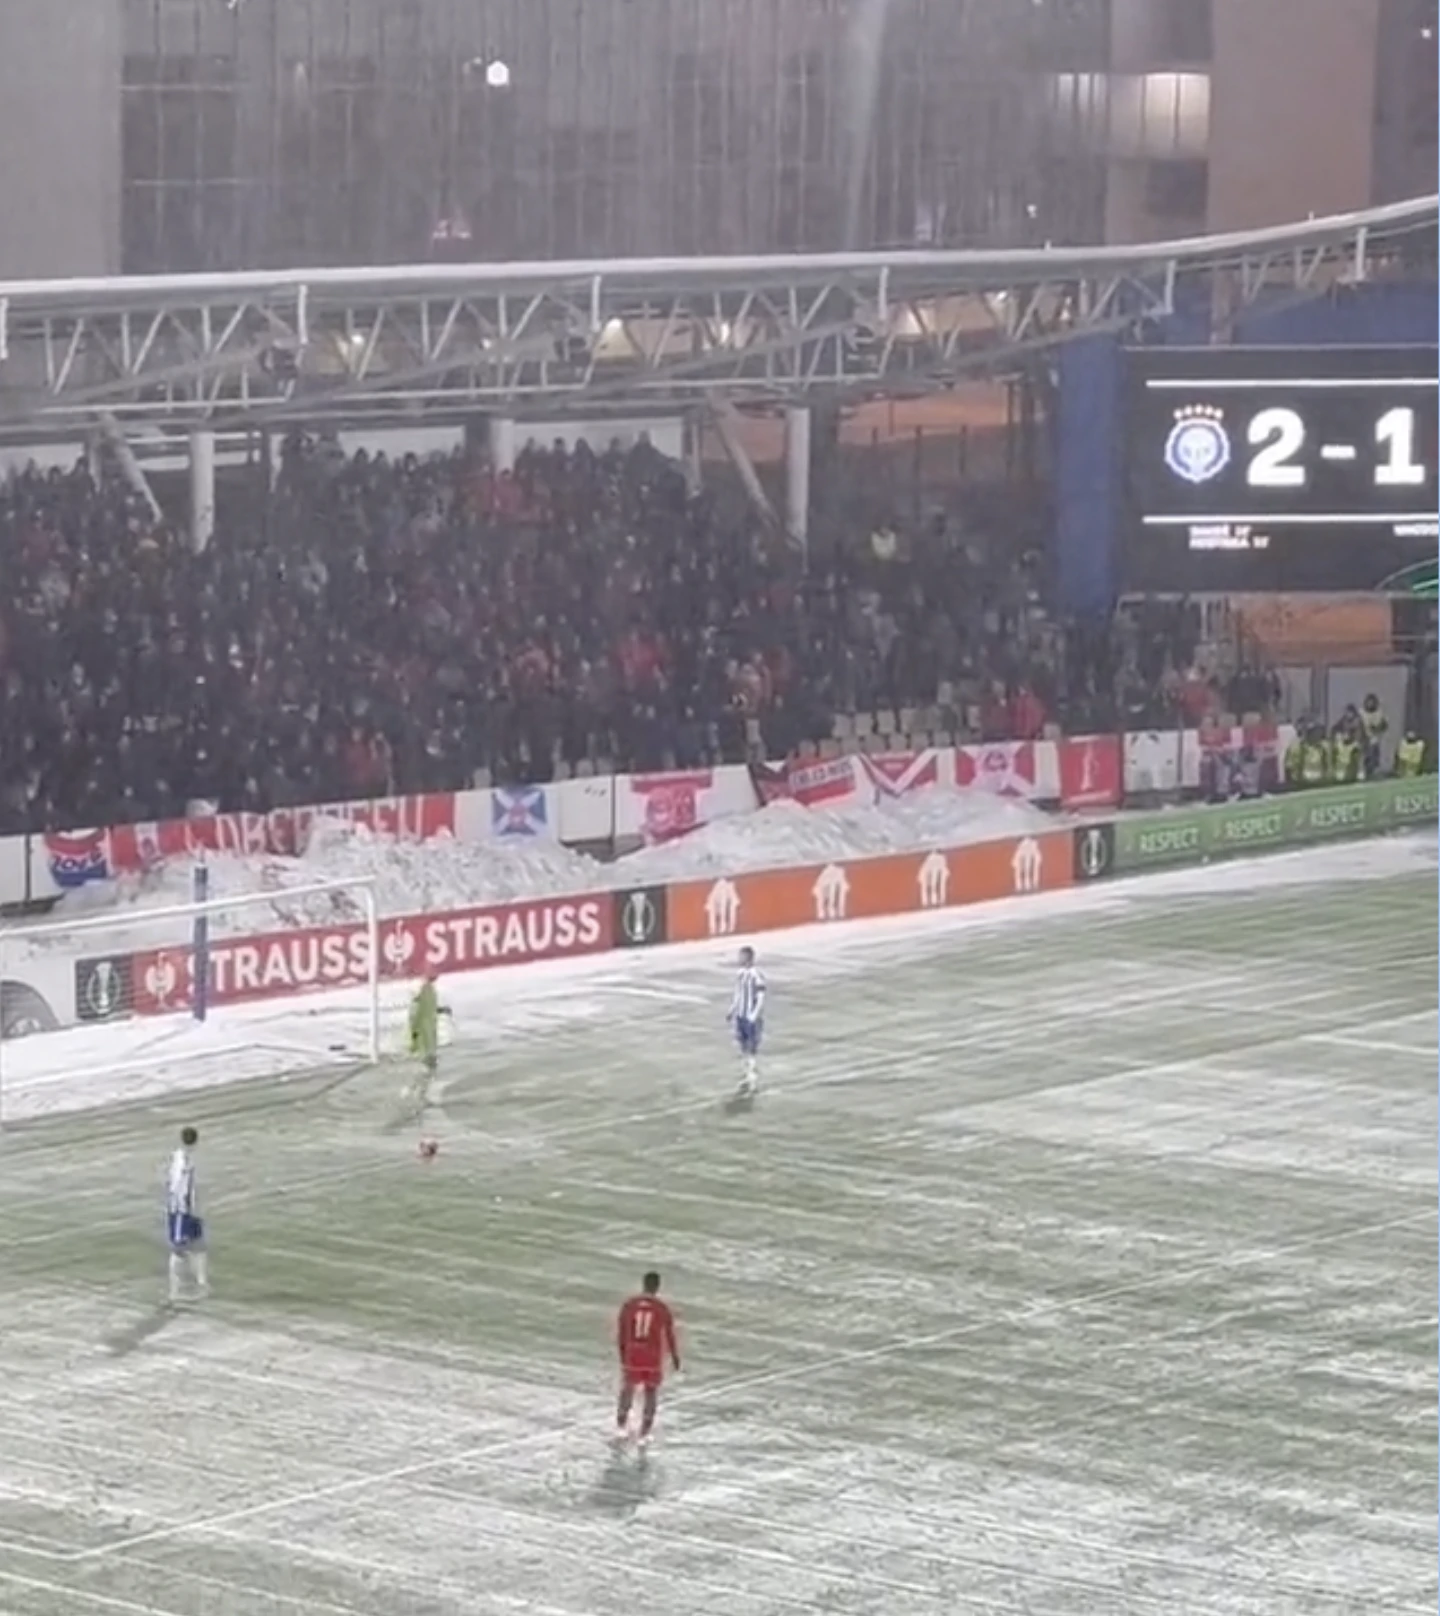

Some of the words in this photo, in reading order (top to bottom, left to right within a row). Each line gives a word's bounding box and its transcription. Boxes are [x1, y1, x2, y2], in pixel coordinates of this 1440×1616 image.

[1224, 813, 1282, 840] RESPECT
[1310, 801, 1366, 827] RESPECT
[1139, 826, 1199, 853] RESPECT
[425, 902, 601, 965] STRAUSS
